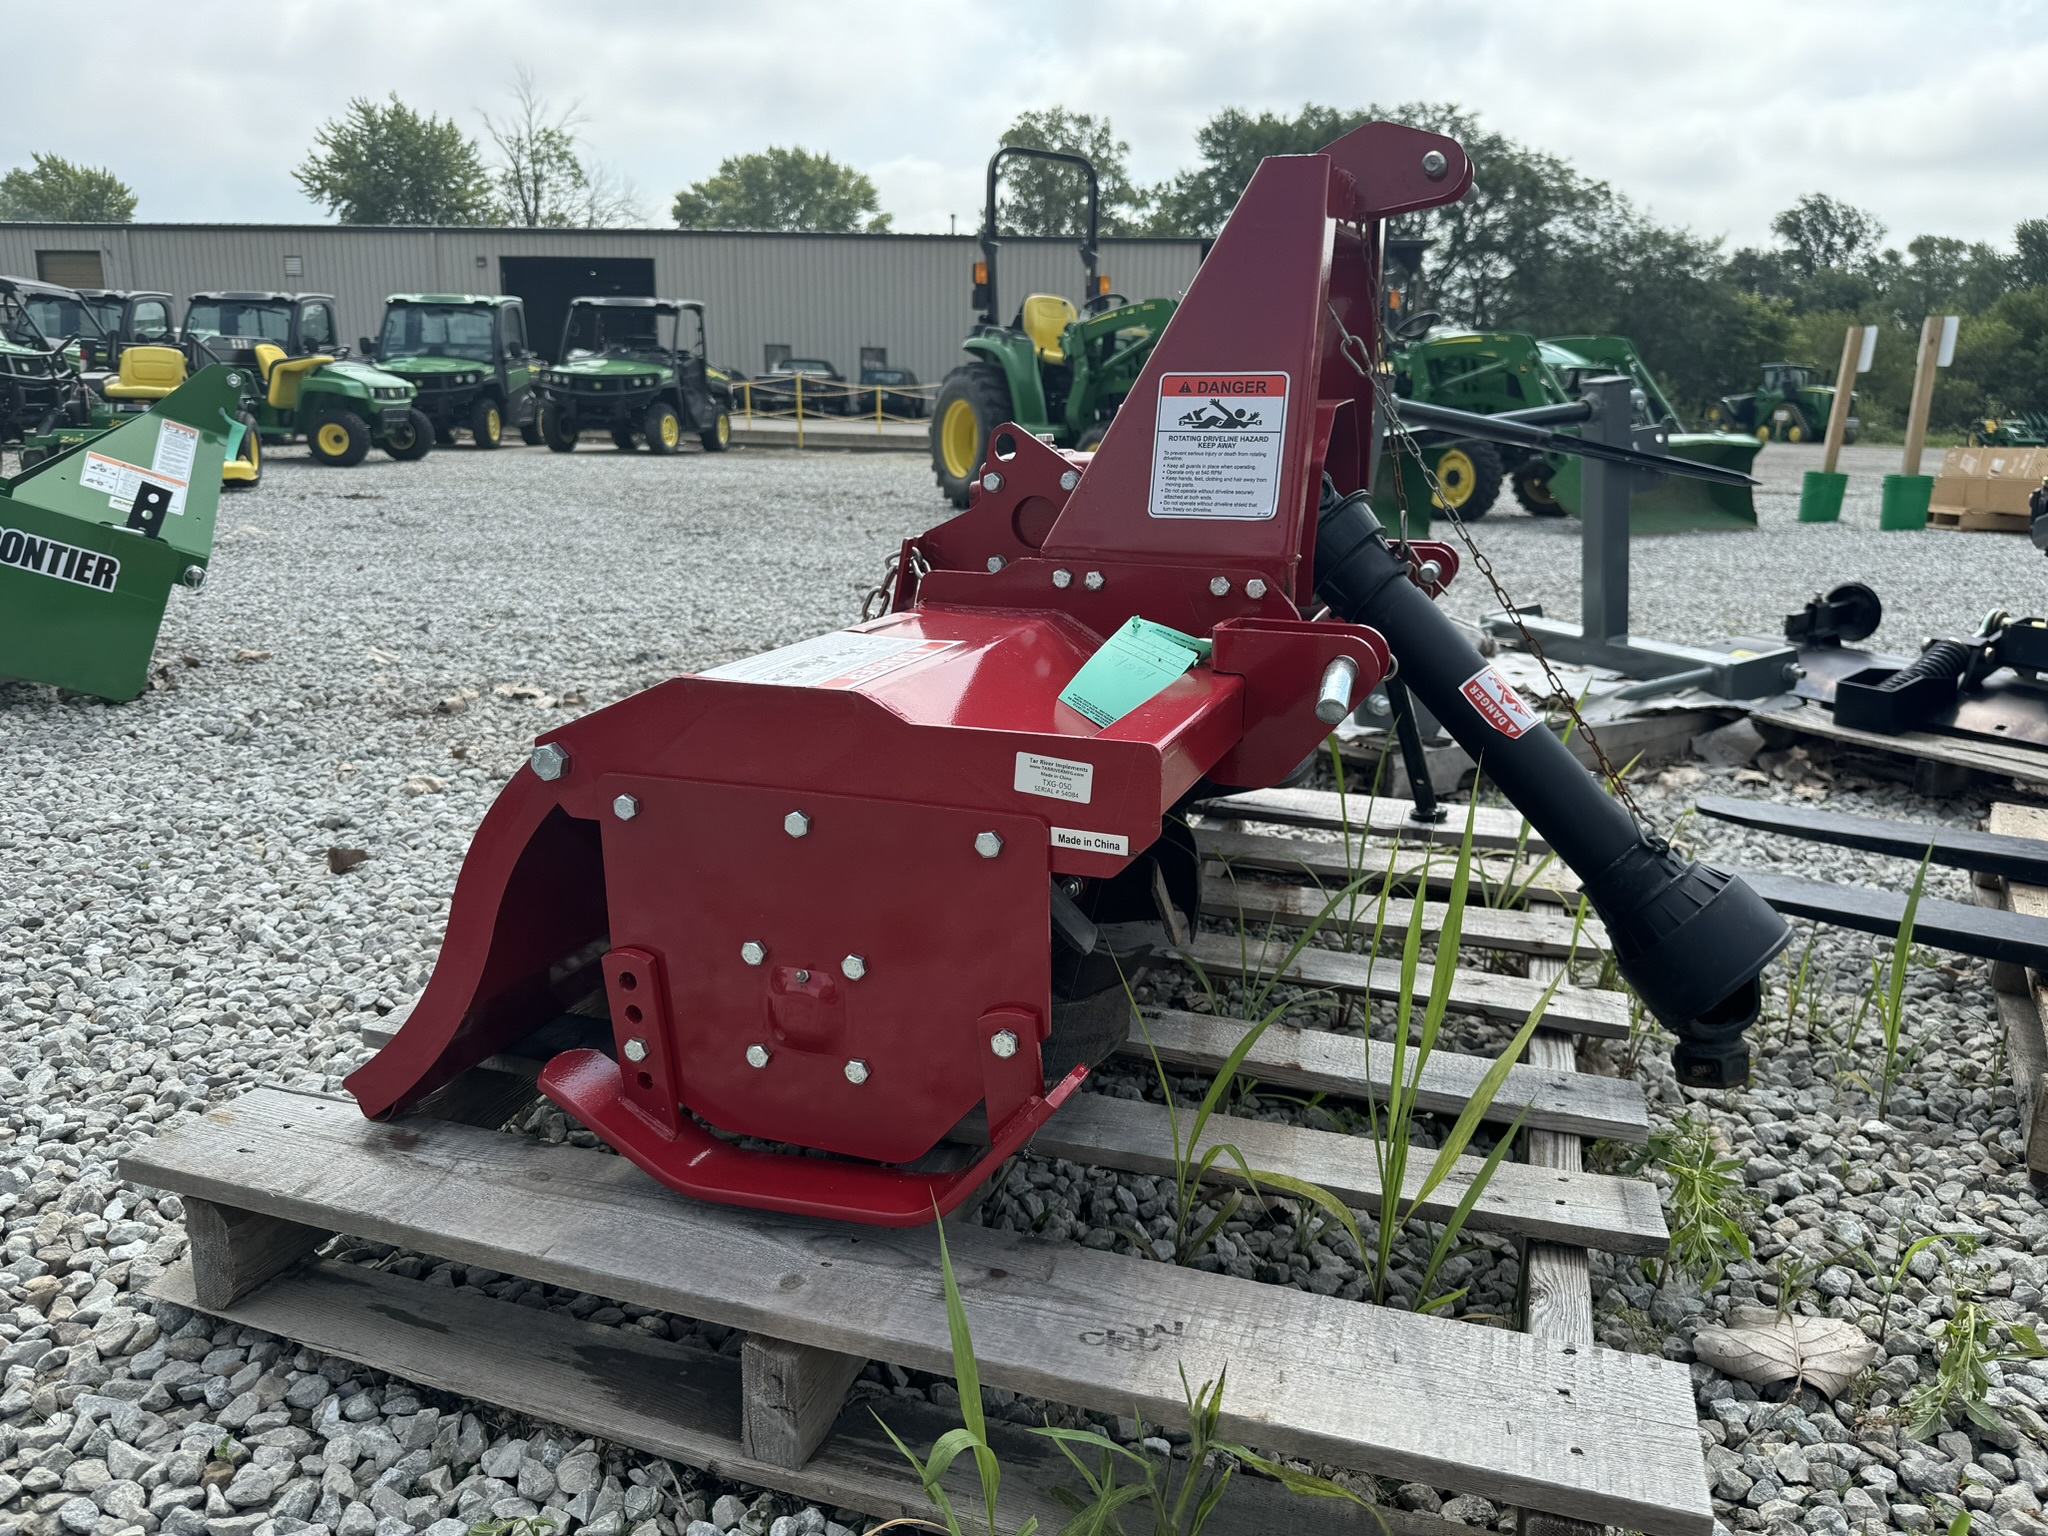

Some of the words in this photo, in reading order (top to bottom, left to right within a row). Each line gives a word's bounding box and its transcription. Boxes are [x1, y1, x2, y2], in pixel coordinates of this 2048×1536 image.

[1197, 381, 1267, 393] DANGER
[0, 531, 118, 590] ONTIER
[1468, 684, 1508, 726] DANGER
[1040, 759, 1054, 767] River
[1055, 762, 1088, 773] Implements
[1034, 785, 1053, 795] SERIAL
[1061, 790, 1079, 798] 54084
[1042, 778, 1072, 791] TXG-050
[1058, 833, 1081, 846] Made
[1083, 836, 1092, 847] in
[1094, 838, 1120, 851] China
